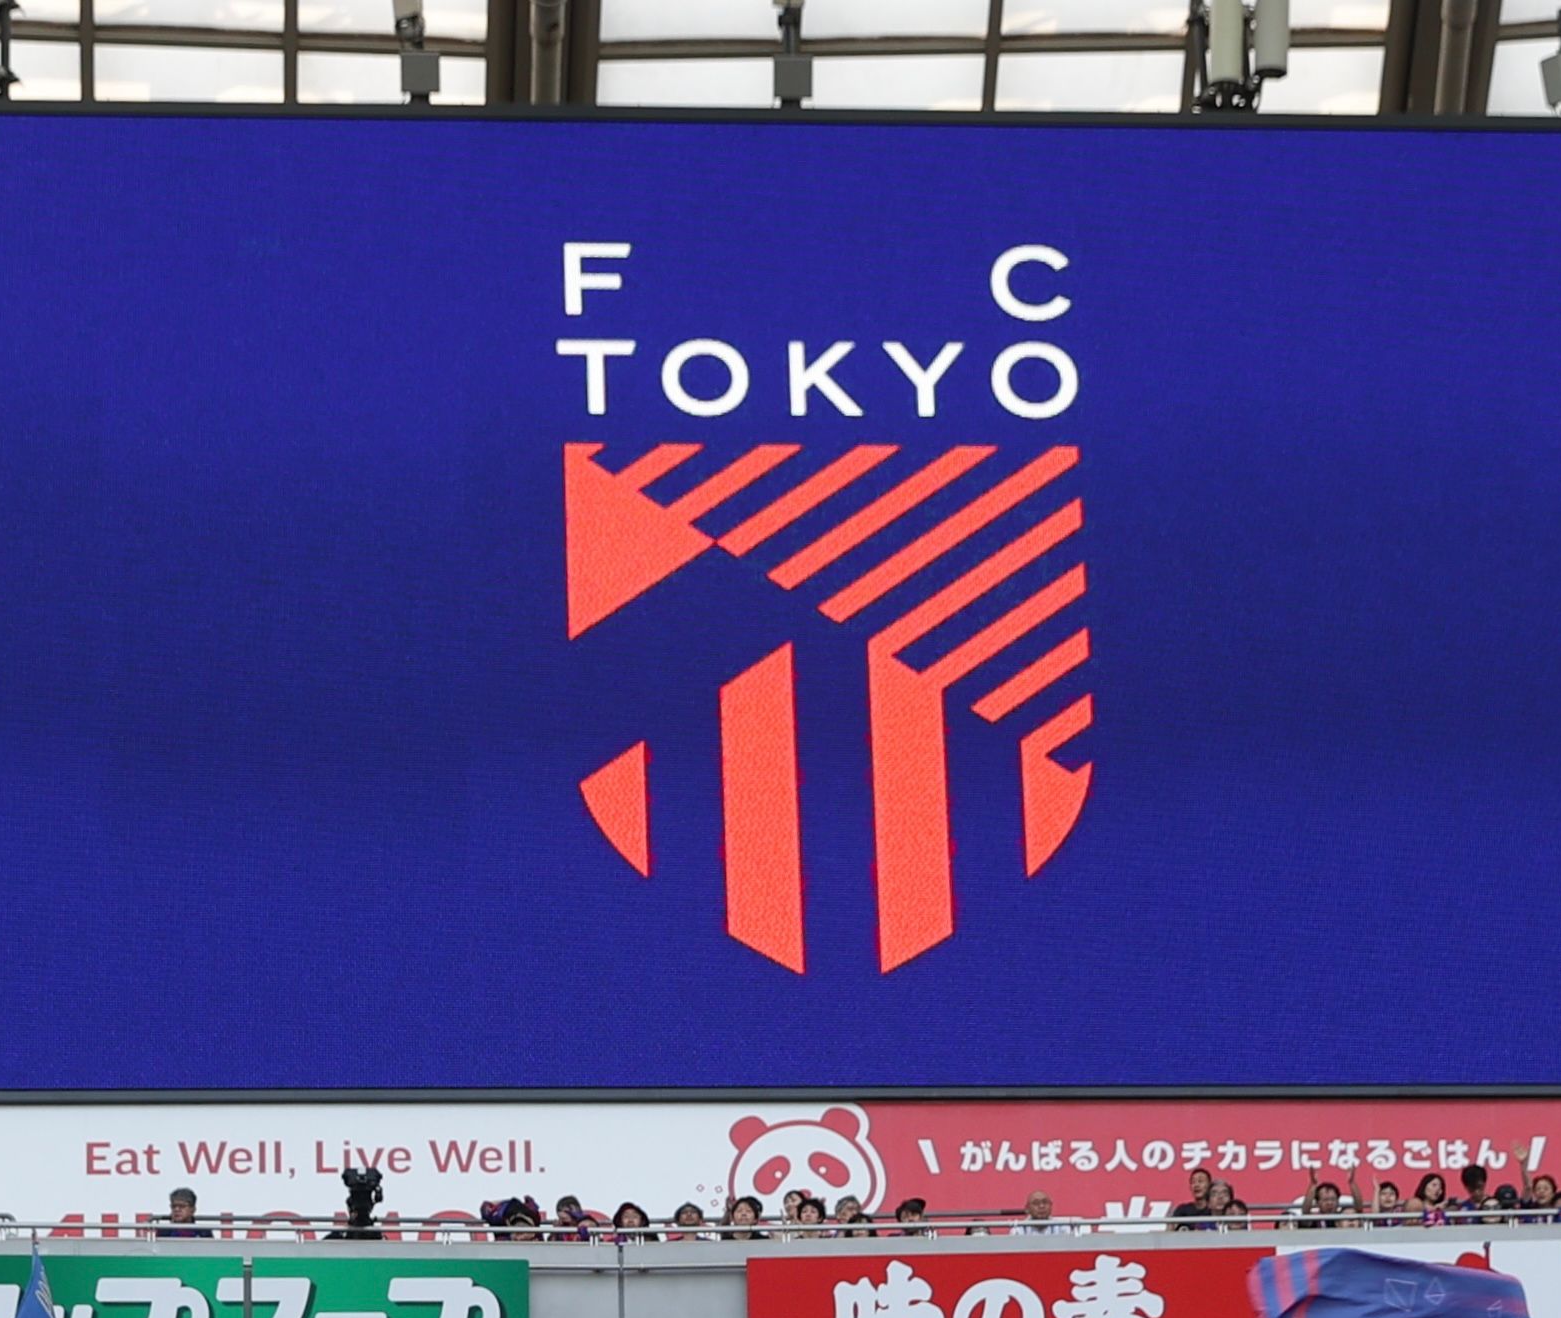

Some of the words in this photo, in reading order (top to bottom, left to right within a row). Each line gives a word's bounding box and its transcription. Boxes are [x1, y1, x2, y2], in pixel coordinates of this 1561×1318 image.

[564, 242, 631, 315] F
[990, 244, 1071, 321] C
[556, 338, 1079, 419] TOKYO
[85, 1141, 161, 1175] Eat
[178, 1140, 296, 1179] Well,
[315, 1140, 412, 1175] Live
[430, 1139, 547, 1174] Well.
